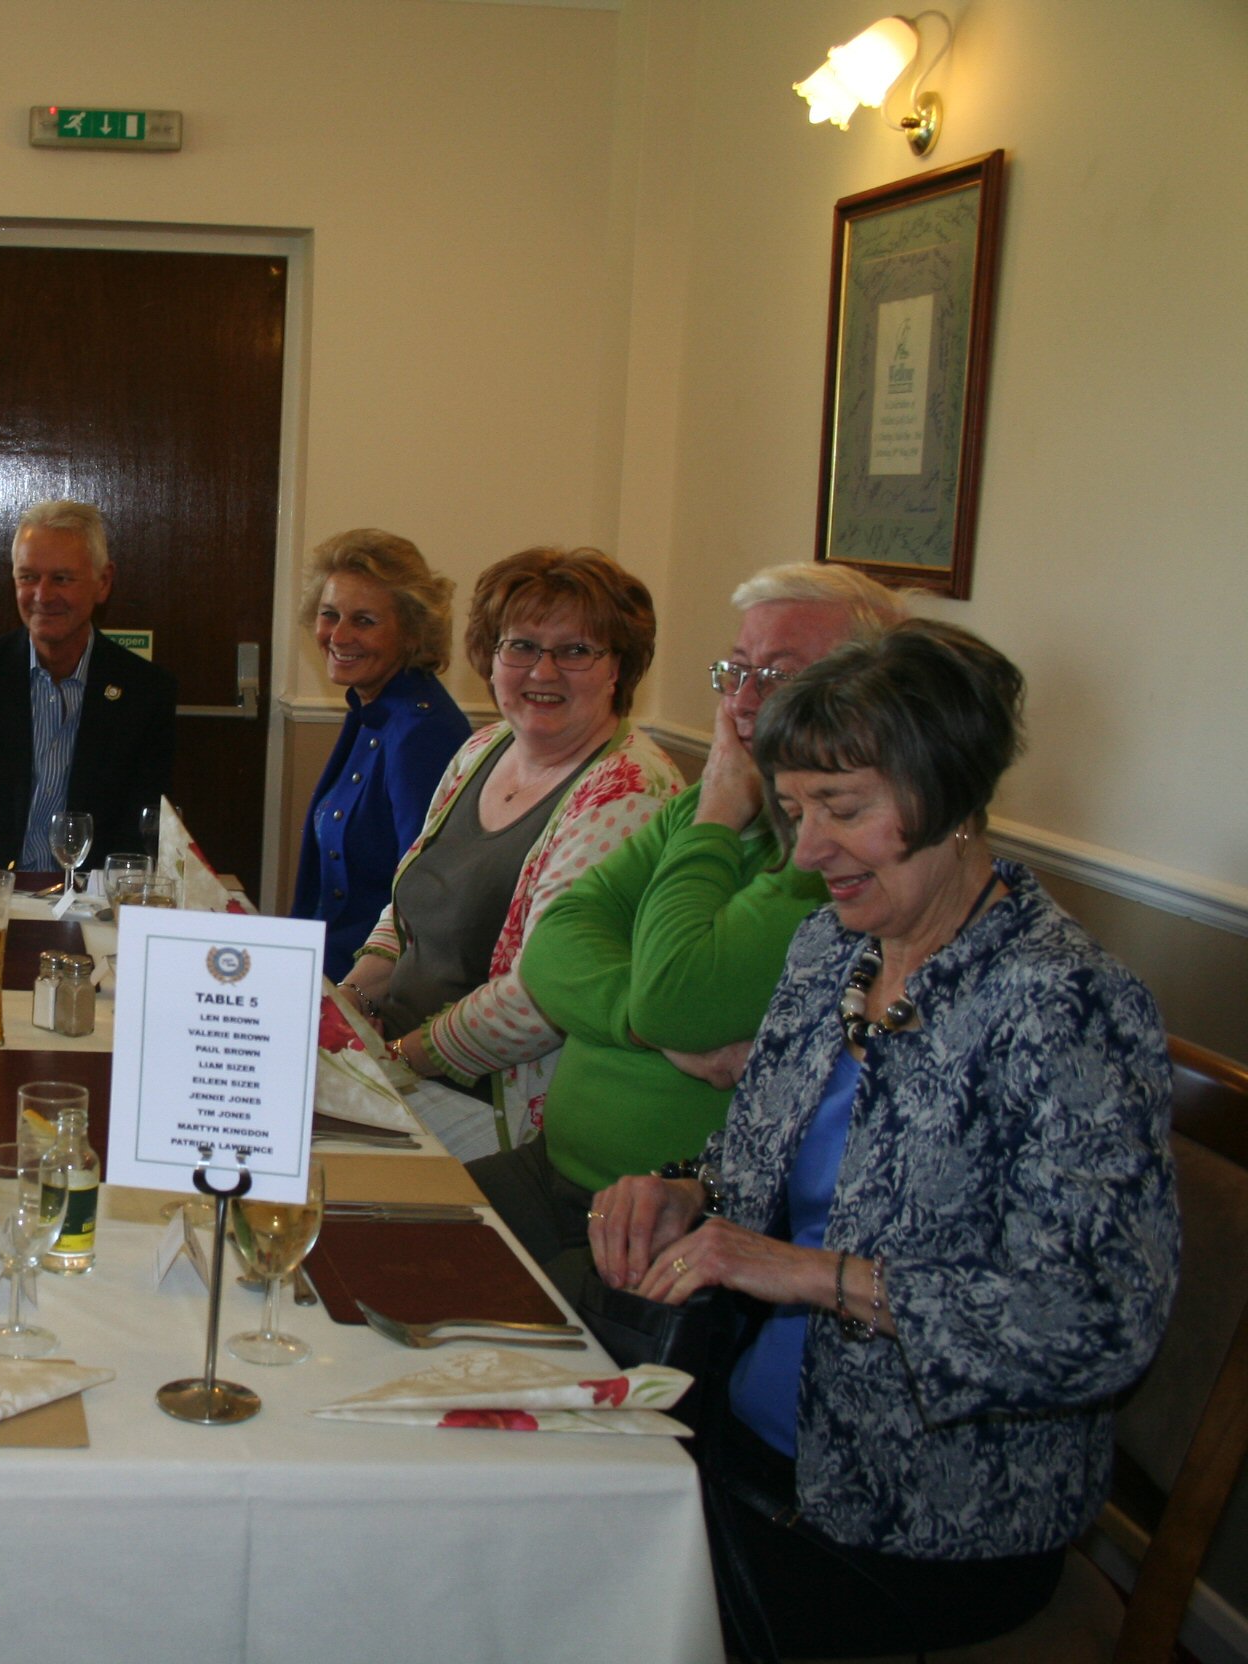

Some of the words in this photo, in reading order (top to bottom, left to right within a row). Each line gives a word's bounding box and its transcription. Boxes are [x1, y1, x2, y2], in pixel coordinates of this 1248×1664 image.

[118, 637, 145, 648] open
[195, 992, 245, 1007] TABLE
[250, 997, 259, 1008] 5
[200, 1014, 219, 1022] LEN
[222, 1015, 260, 1025] BROWN
[188, 1029, 230, 1039] VALERIE
[233, 1032, 270, 1042] BROWN
[195, 1045, 220, 1054] PAUL
[223, 1048, 261, 1057] BROWN
[199, 1061, 223, 1070] LIAM
[226, 1064, 255, 1073] SIZER
[192, 1076, 228, 1086] EILEEN
[231, 1080, 260, 1089] SIZER
[189, 1092, 225, 1102] JENNIE
[228, 1096, 261, 1105] JONES
[197, 1108, 215, 1117] TIM
[218, 1111, 251, 1120] JONES
[177, 1123, 220, 1133] MARTYN
[222, 1127, 269, 1138] KINGDON
